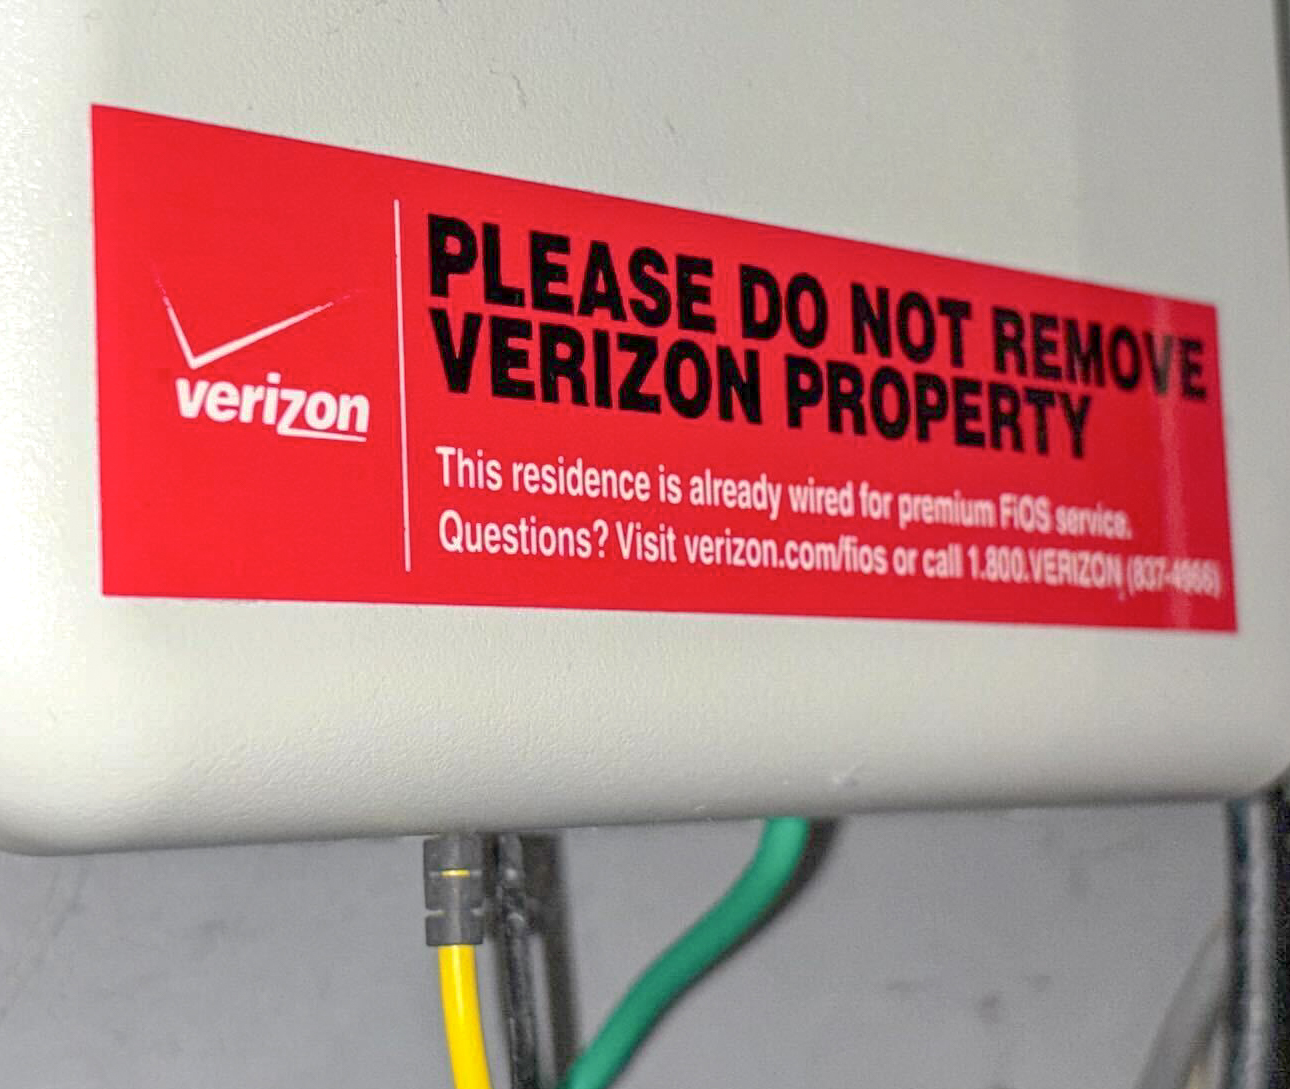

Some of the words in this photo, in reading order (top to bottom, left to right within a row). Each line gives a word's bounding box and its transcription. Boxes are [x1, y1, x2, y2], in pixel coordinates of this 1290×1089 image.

[427, 212, 717, 335] PLEASE
[739, 263, 829, 349] DO
[850, 282, 972, 368] NOT
[991, 306, 1207, 400] REMOVE
[175, 371, 371, 442] verizon
[428, 306, 763, 426] VERIZON
[784, 353, 1093, 460] PROPERTY
[435, 445, 504, 492] This
[512, 456, 652, 503] residence
[658, 464, 683, 505] is
[689, 468, 783, 521] already
[788, 476, 855, 518] wired
[859, 480, 893, 520] for
[898, 489, 997, 531] premium
[999, 491, 1052, 534] FiOS
[1054, 500, 1133, 541] service.
[438, 508, 610, 559] Questions?
[615, 520, 677, 563] Visit
[683, 527, 888, 576] verizon.com/fios
[893, 545, 919, 576] or
[922, 543, 963, 579] call
[967, 545, 1124, 590] 1.800.VERIZON
